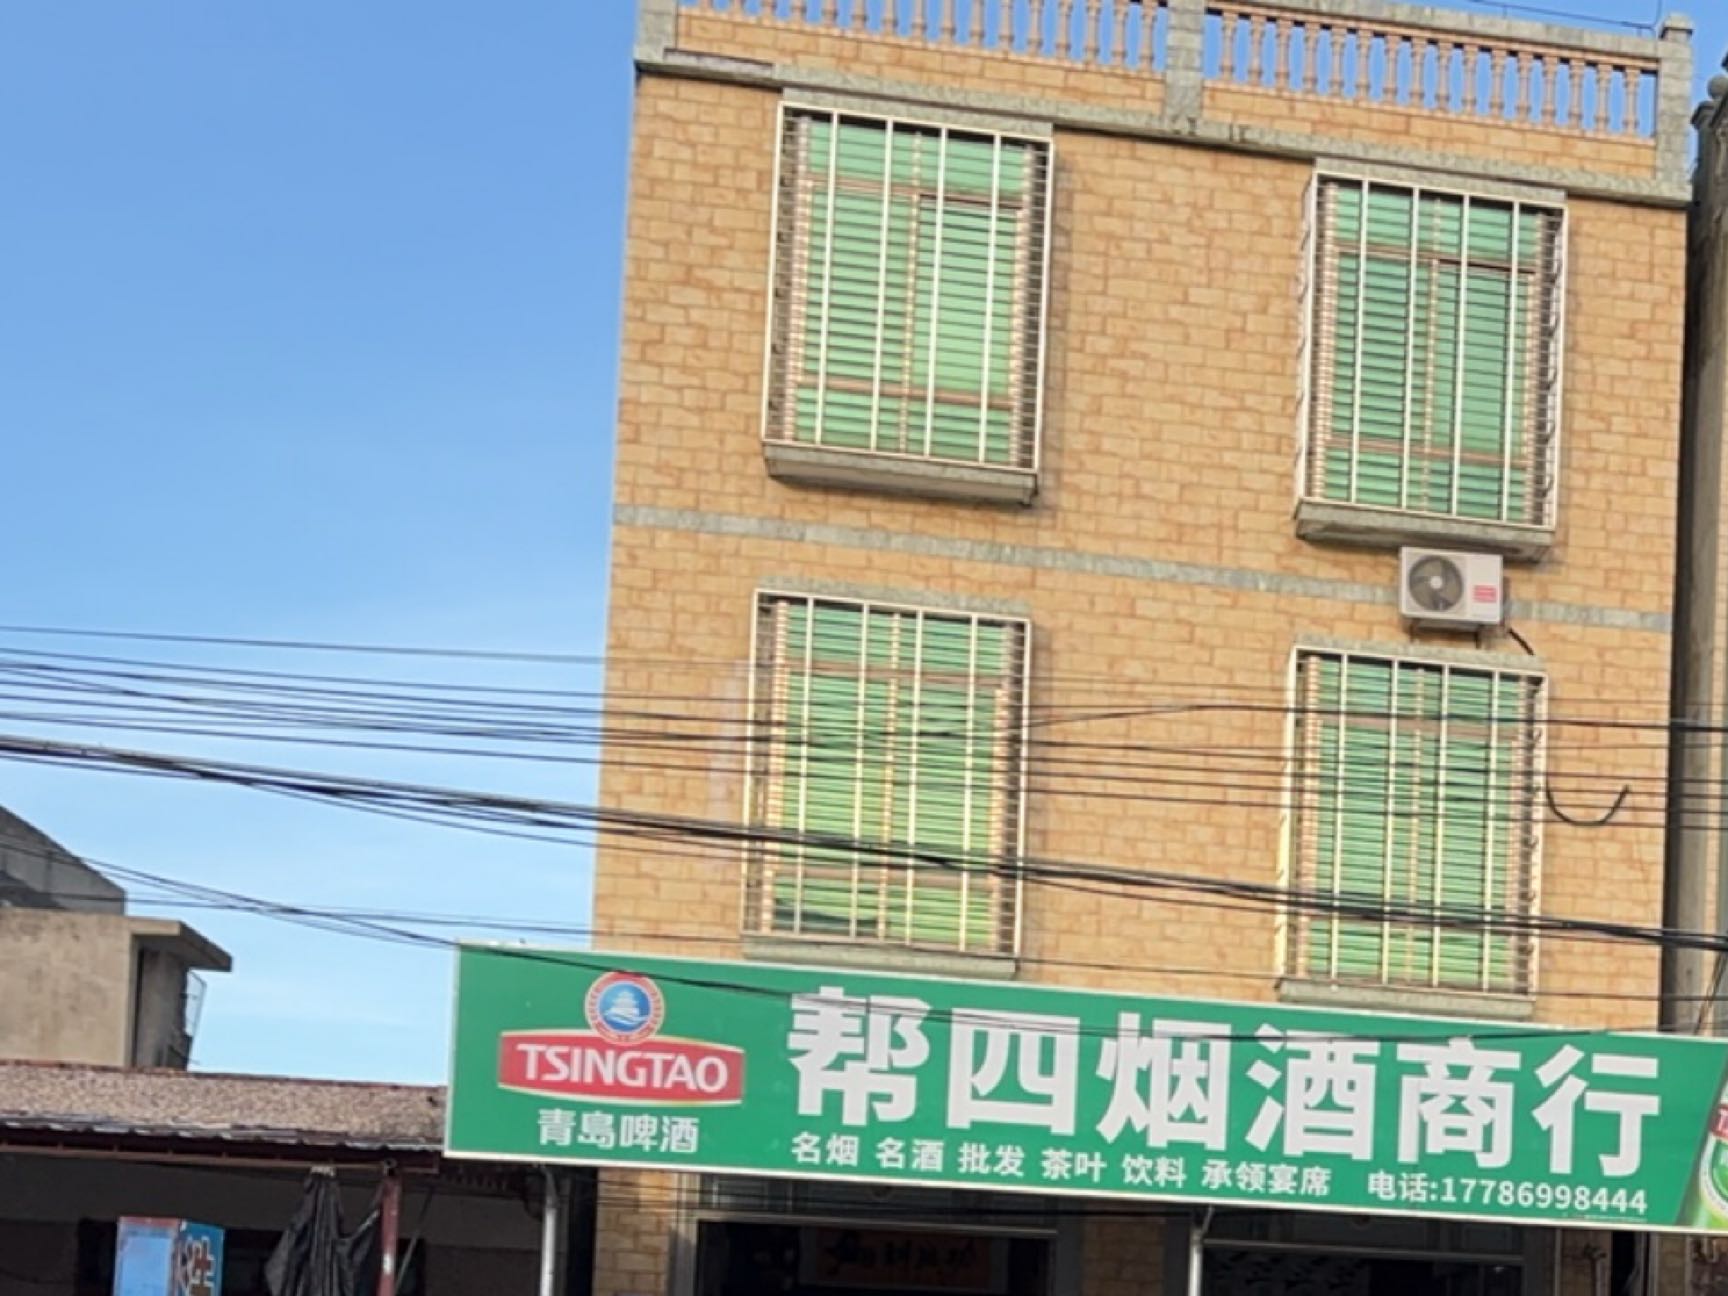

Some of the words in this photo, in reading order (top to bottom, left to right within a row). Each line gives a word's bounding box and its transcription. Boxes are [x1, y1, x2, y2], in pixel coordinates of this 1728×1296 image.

[516, 1042, 729, 1093] TSINGTAO
[787, 986, 1660, 1177] 帮四烟酒商行
[792, 1131, 859, 1166] 名烟
[876, 1137, 944, 1172] 名酒
[958, 1142, 1024, 1177] 批发
[1041, 1148, 1107, 1183] 茶叶
[1122, 1153, 1187, 1188] 饮料
[1202, 1159, 1331, 1196] 承领宴席
[1368, 1169, 1647, 1214] 电话:17786998444
